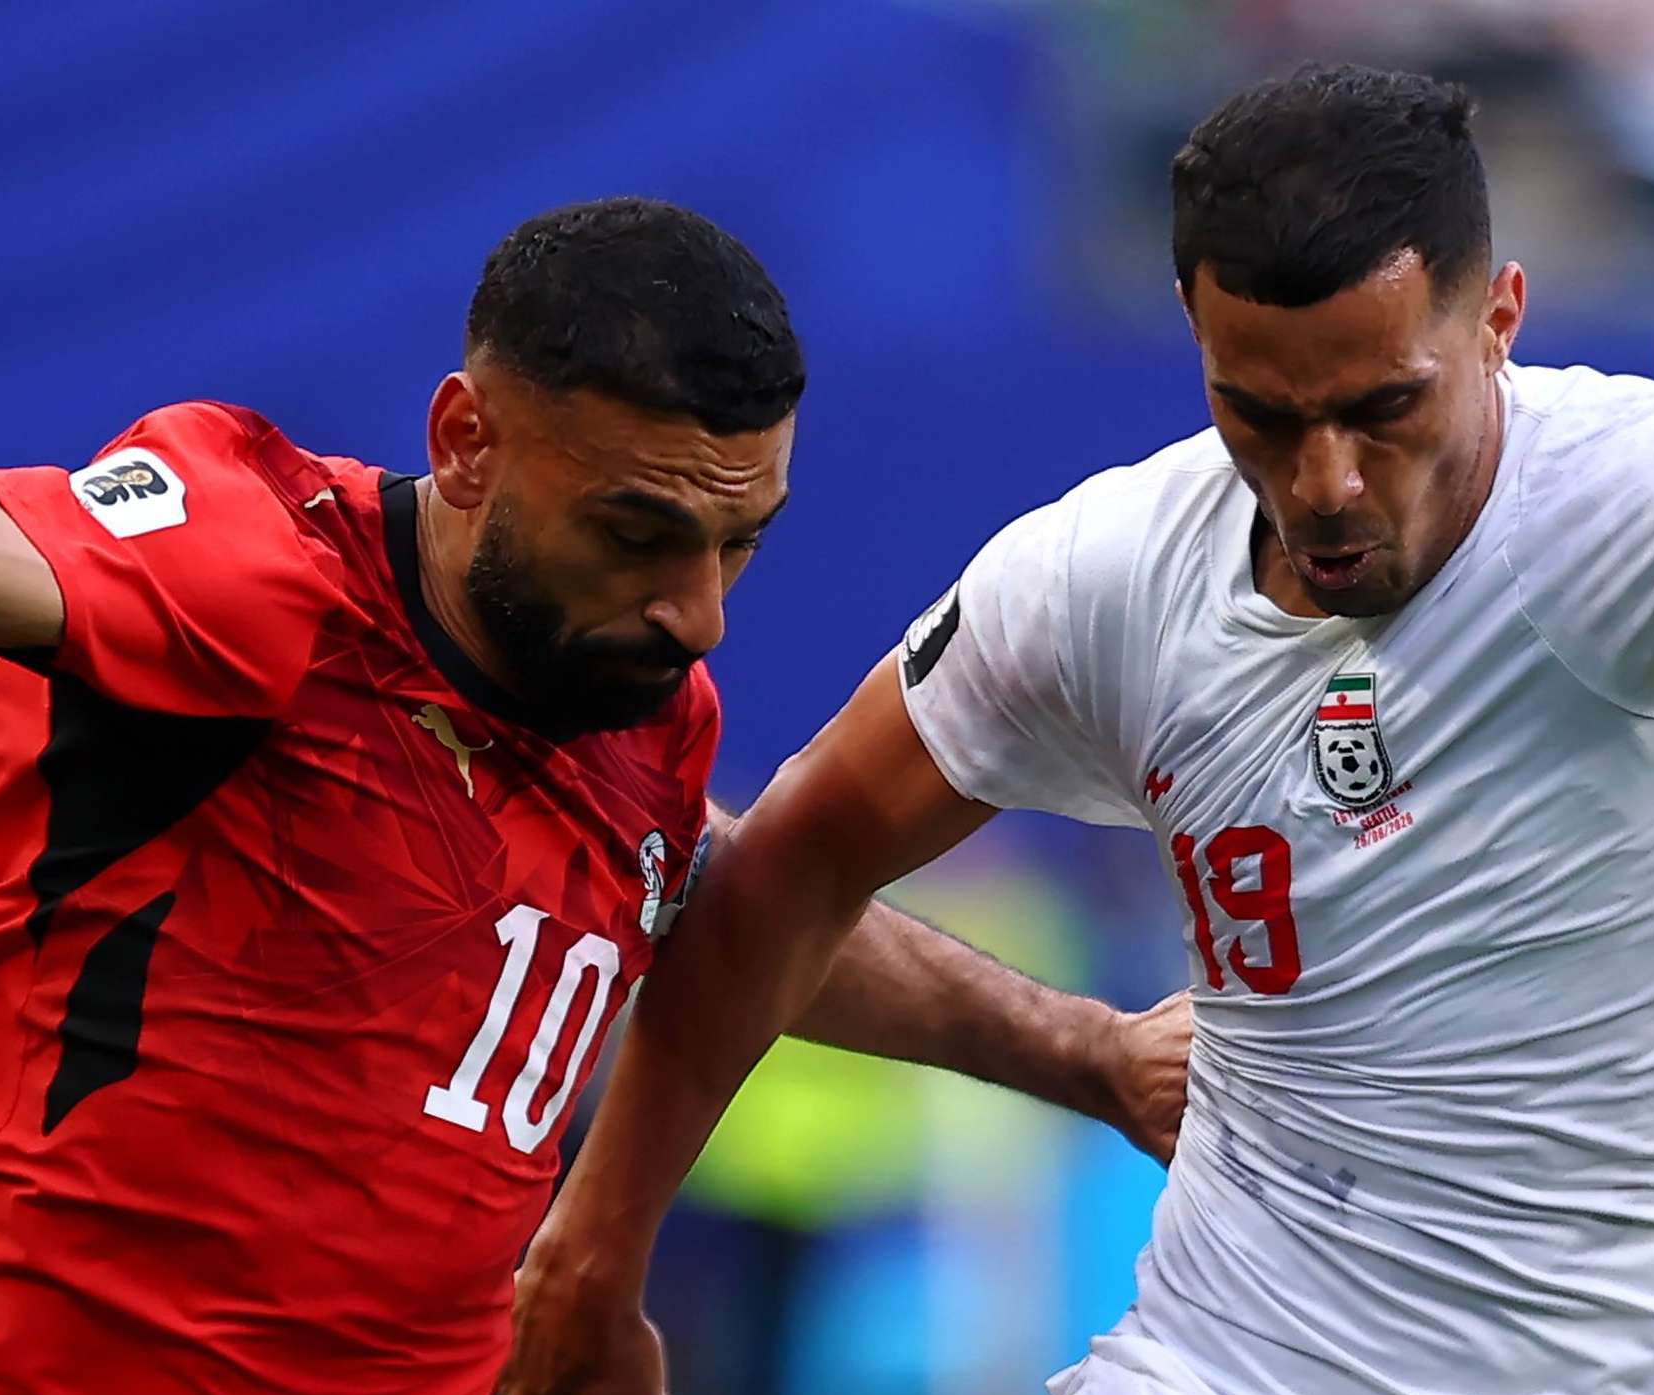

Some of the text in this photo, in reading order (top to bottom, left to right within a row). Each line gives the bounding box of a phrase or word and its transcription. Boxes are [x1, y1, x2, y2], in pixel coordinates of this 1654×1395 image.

[1359, 803, 1400, 832] SEATTLE
[1170, 825, 1302, 995] 19
[423, 903, 620, 1154] 10
